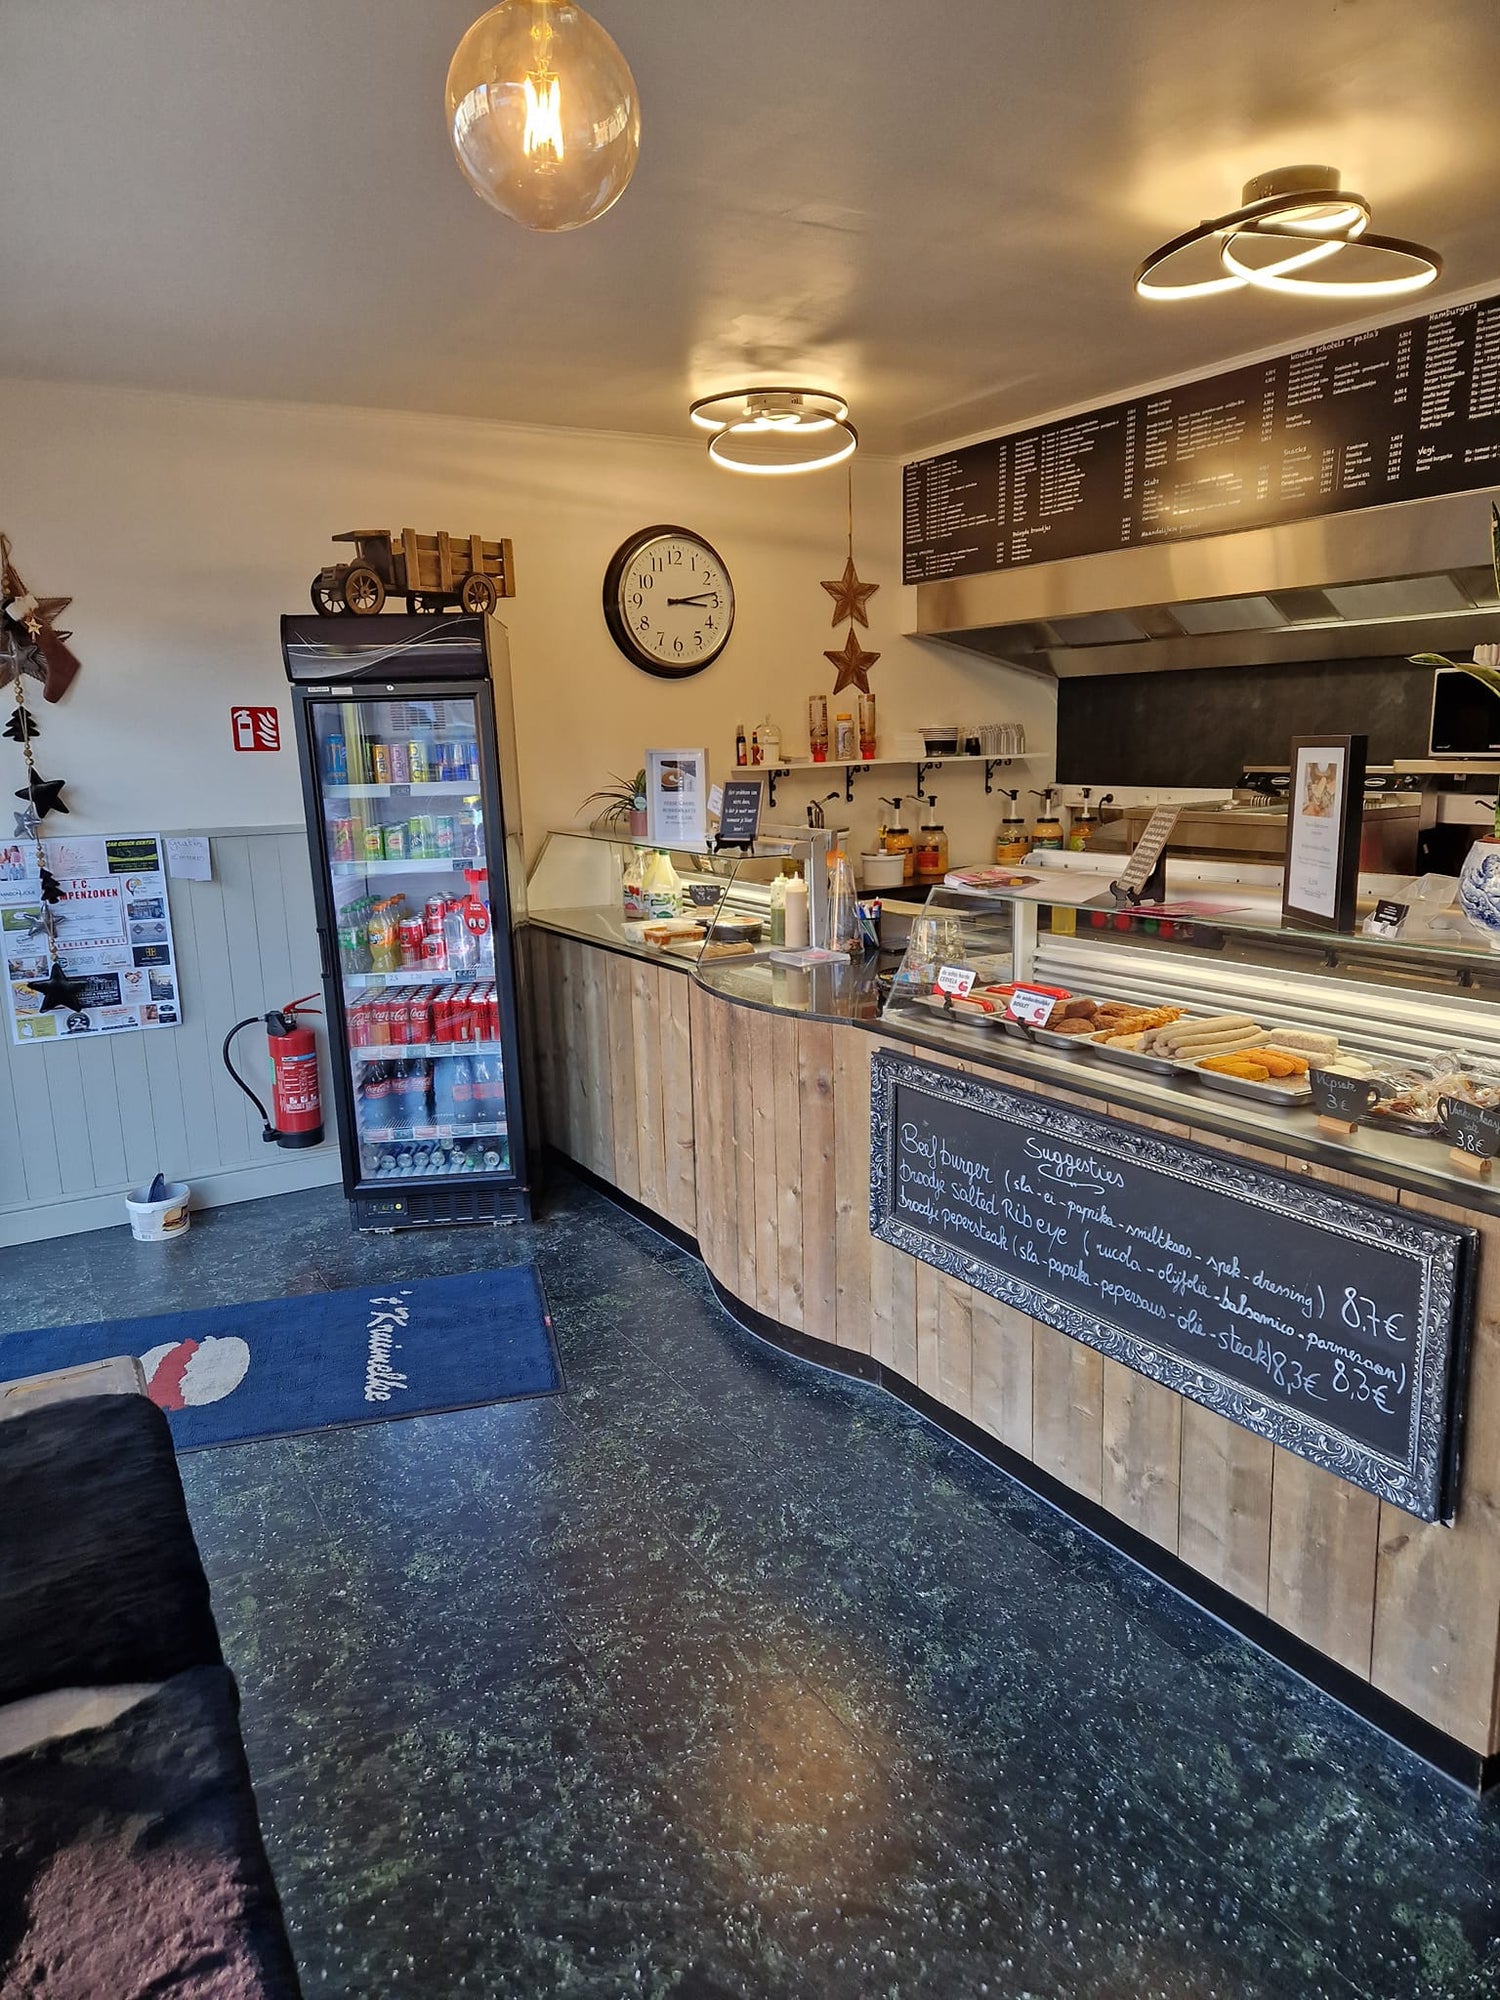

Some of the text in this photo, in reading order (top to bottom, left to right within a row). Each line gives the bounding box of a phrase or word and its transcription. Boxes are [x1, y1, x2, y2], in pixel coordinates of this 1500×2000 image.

[1429, 303, 1478, 321] Hamburgers
[1417, 445, 1435, 456] Vegi
[651, 557, 663, 572] 11
[668, 550, 683, 565] 12
[691, 556, 695, 572] 1
[639, 574, 654, 589] 10
[702, 571, 711, 586] 2
[632, 592, 643, 609] 9
[710, 592, 719, 609] 3
[640, 615, 650, 631] 8
[704, 614, 714, 629] 4
[656, 631, 665, 646] 7
[673, 636, 684, 652] 6
[693, 631, 703, 646] 5
[59, 888, 118, 901] MPENZONEN
[1327, 1094, 1338, 1109] 3
[1023, 1137, 1125, 1188] Suggesties
[1036, 1218, 1068, 1253] eye
